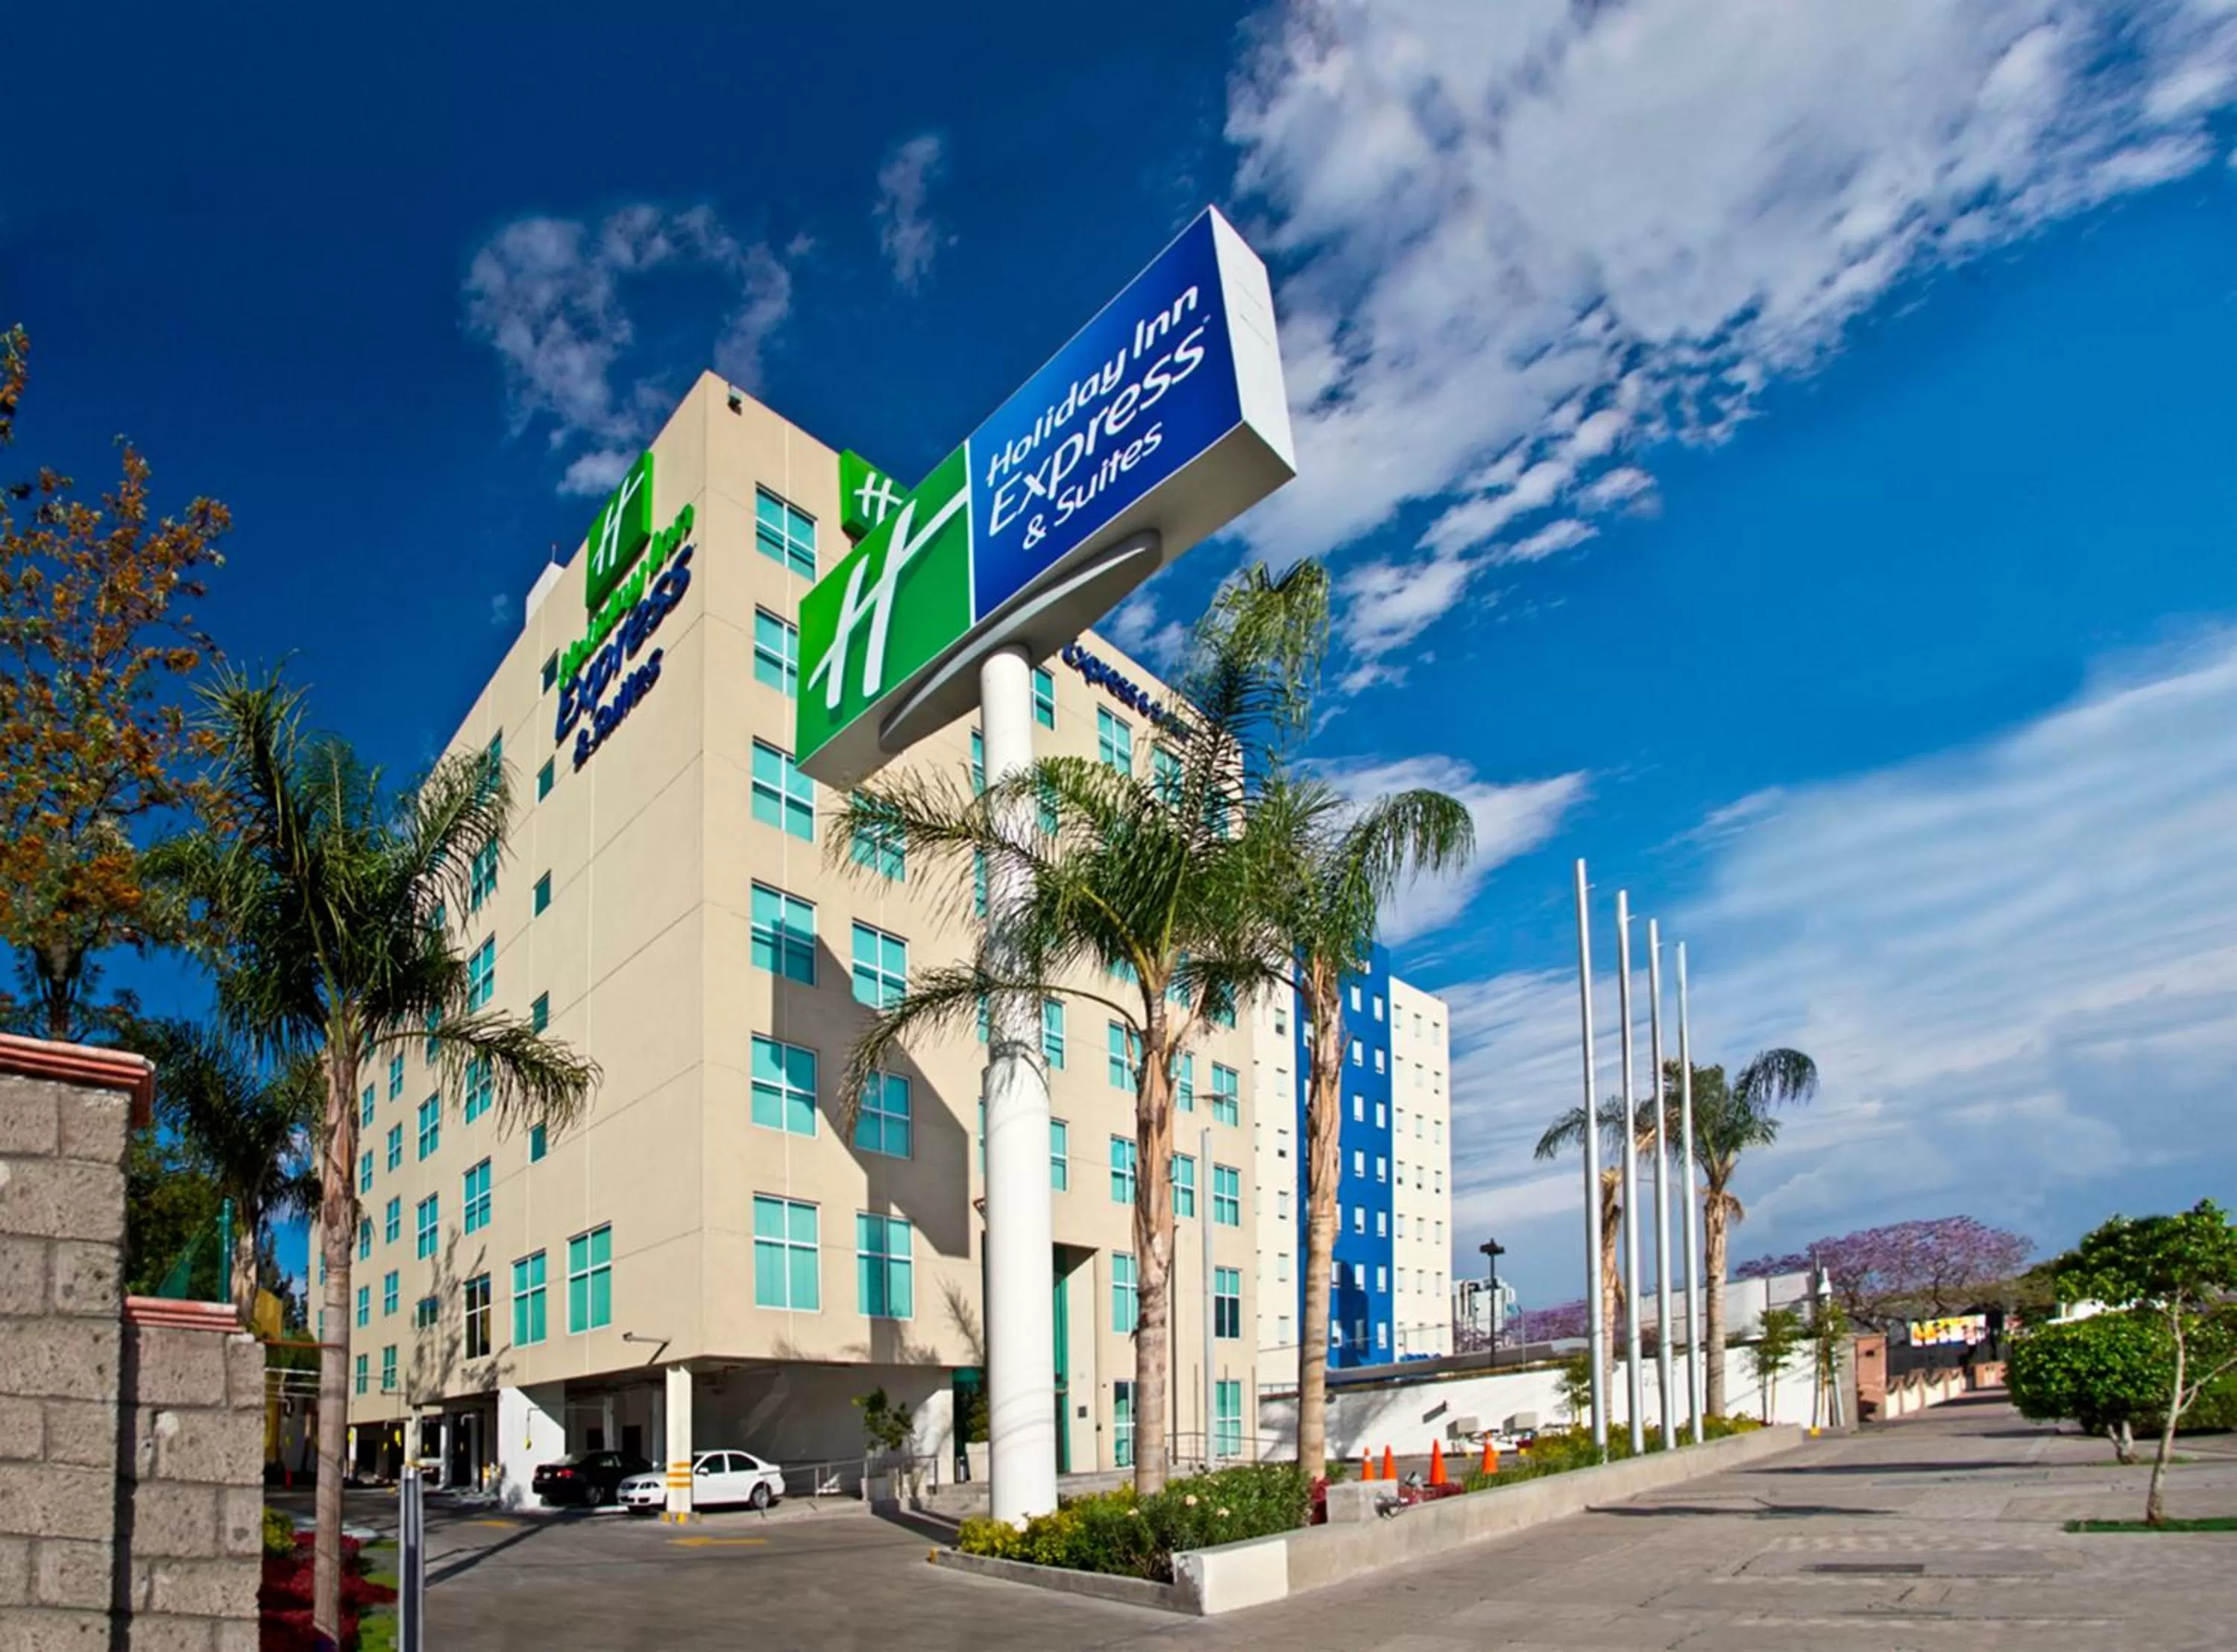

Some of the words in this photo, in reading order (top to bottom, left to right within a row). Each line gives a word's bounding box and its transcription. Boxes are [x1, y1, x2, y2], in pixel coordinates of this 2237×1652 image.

[987, 347, 1127, 488] Holiday
[1133, 286, 1198, 359] Inn
[989, 326, 1205, 537] Express
[1022, 513, 1047, 550] &
[1053, 421, 1162, 527] Suites
[592, 471, 645, 576] H
[808, 485, 968, 709] H
